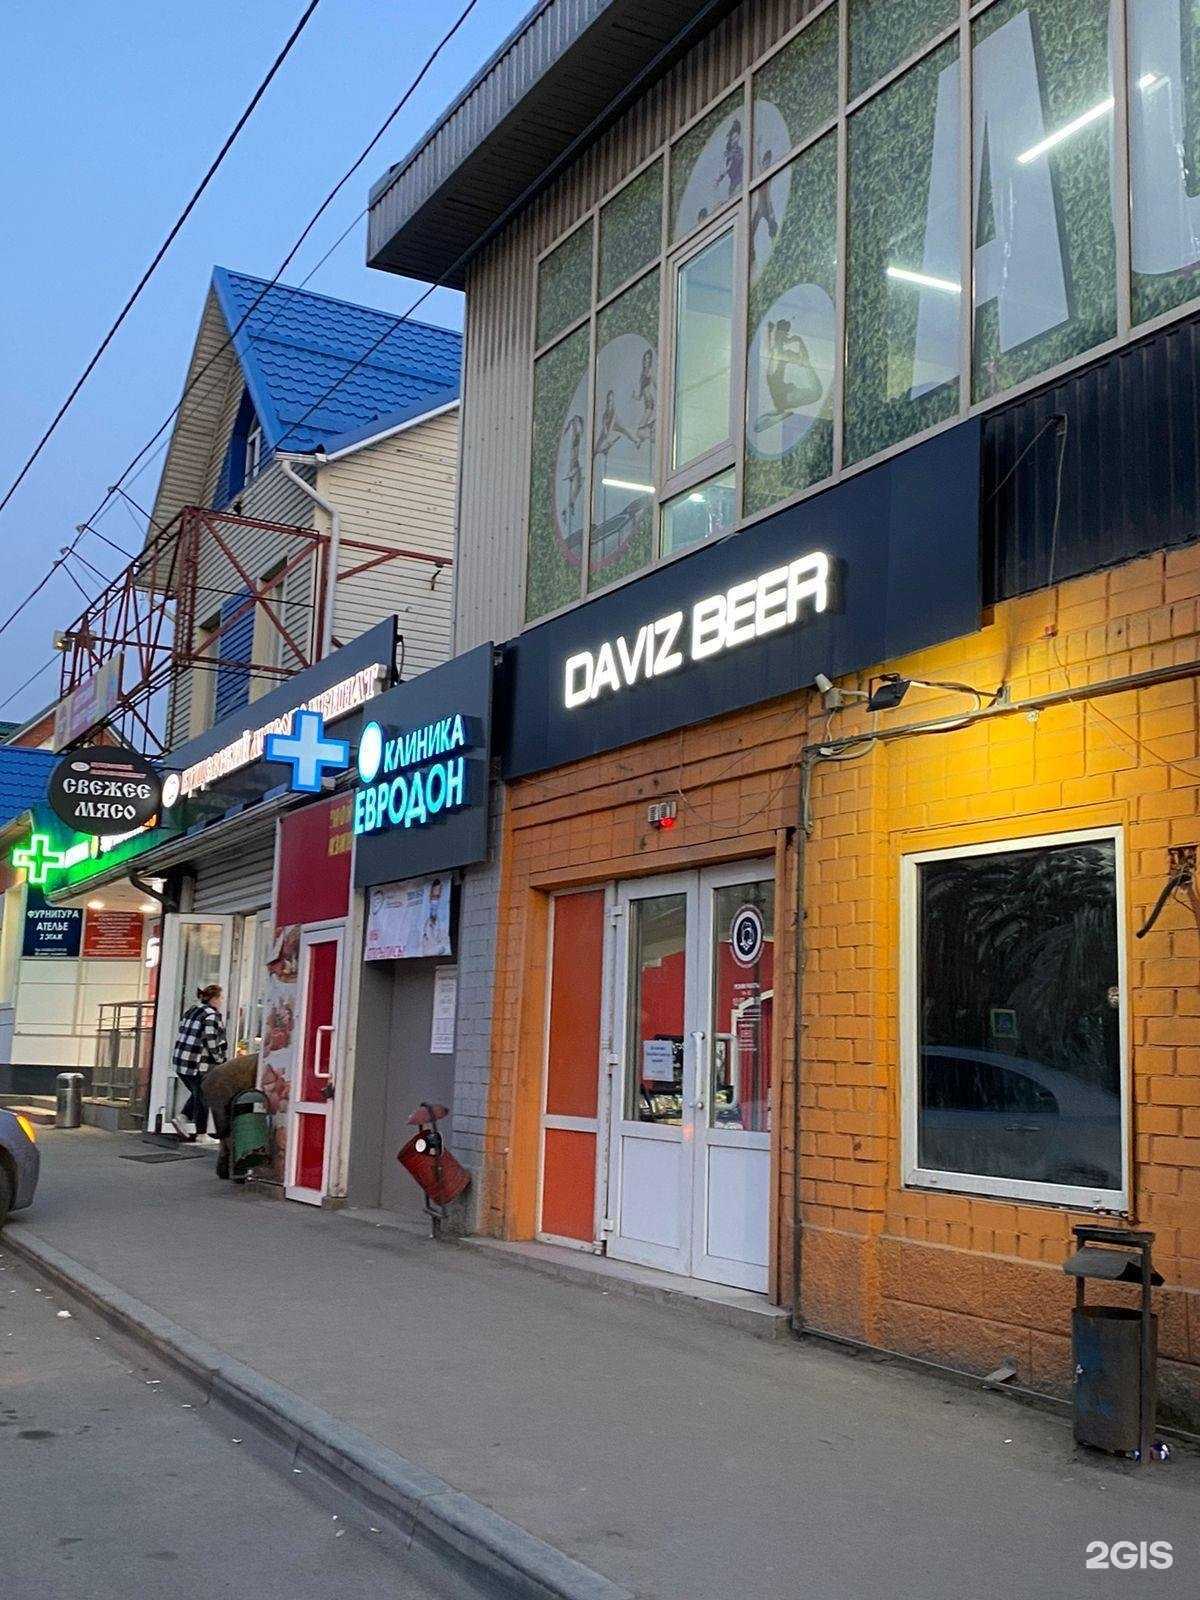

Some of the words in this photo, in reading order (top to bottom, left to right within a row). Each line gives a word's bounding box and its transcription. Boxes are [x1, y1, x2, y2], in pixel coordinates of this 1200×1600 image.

[565, 610, 684, 709] DAVIZ
[691, 551, 830, 661] BEER
[383, 713, 465, 773] КЛИНИКА
[62, 778, 152, 800] СВЕЖЕЕ
[354, 756, 465, 835] ЕВРОДОН
[74, 801, 137, 821] МЯСО
[26, 909, 80, 919] ФУРНИТУРА
[35, 922, 69, 931] АТЕЛЬЕ
